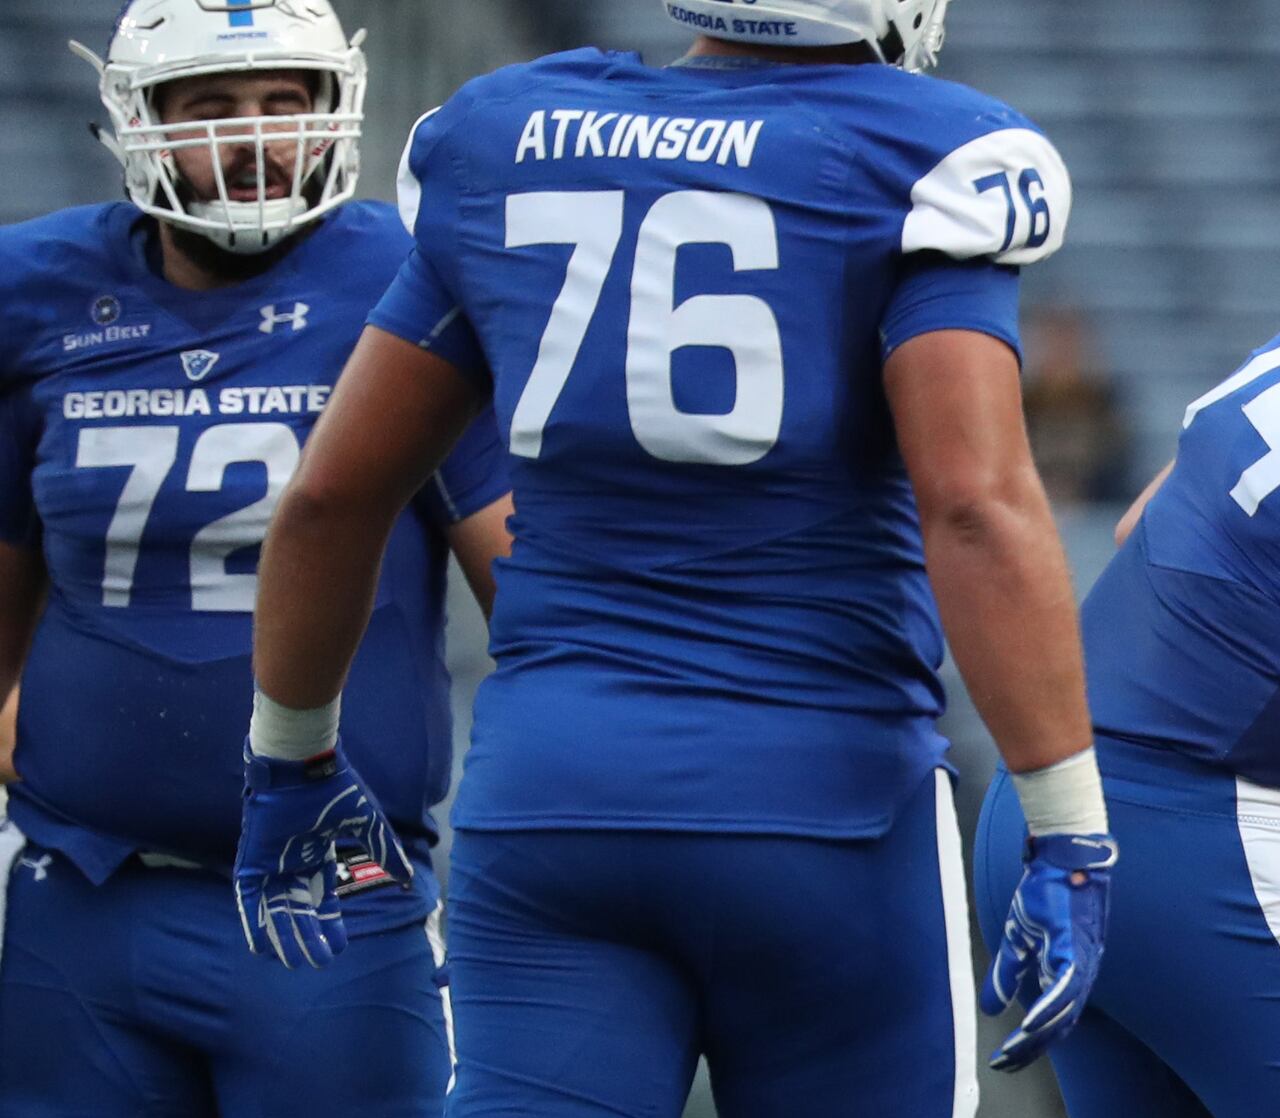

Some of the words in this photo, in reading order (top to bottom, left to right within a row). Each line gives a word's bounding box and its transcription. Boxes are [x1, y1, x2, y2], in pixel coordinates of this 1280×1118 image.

[733, 19, 797, 36] STATE
[514, 109, 764, 168] ATKINSON
[973, 168, 1050, 251] 76
[63, 333, 102, 351] SUN
[105, 324, 151, 340] BELT
[503, 188, 785, 467] 76
[63, 388, 211, 419] GEORGIA
[218, 386, 331, 414] STATE
[76, 422, 300, 612] 72
